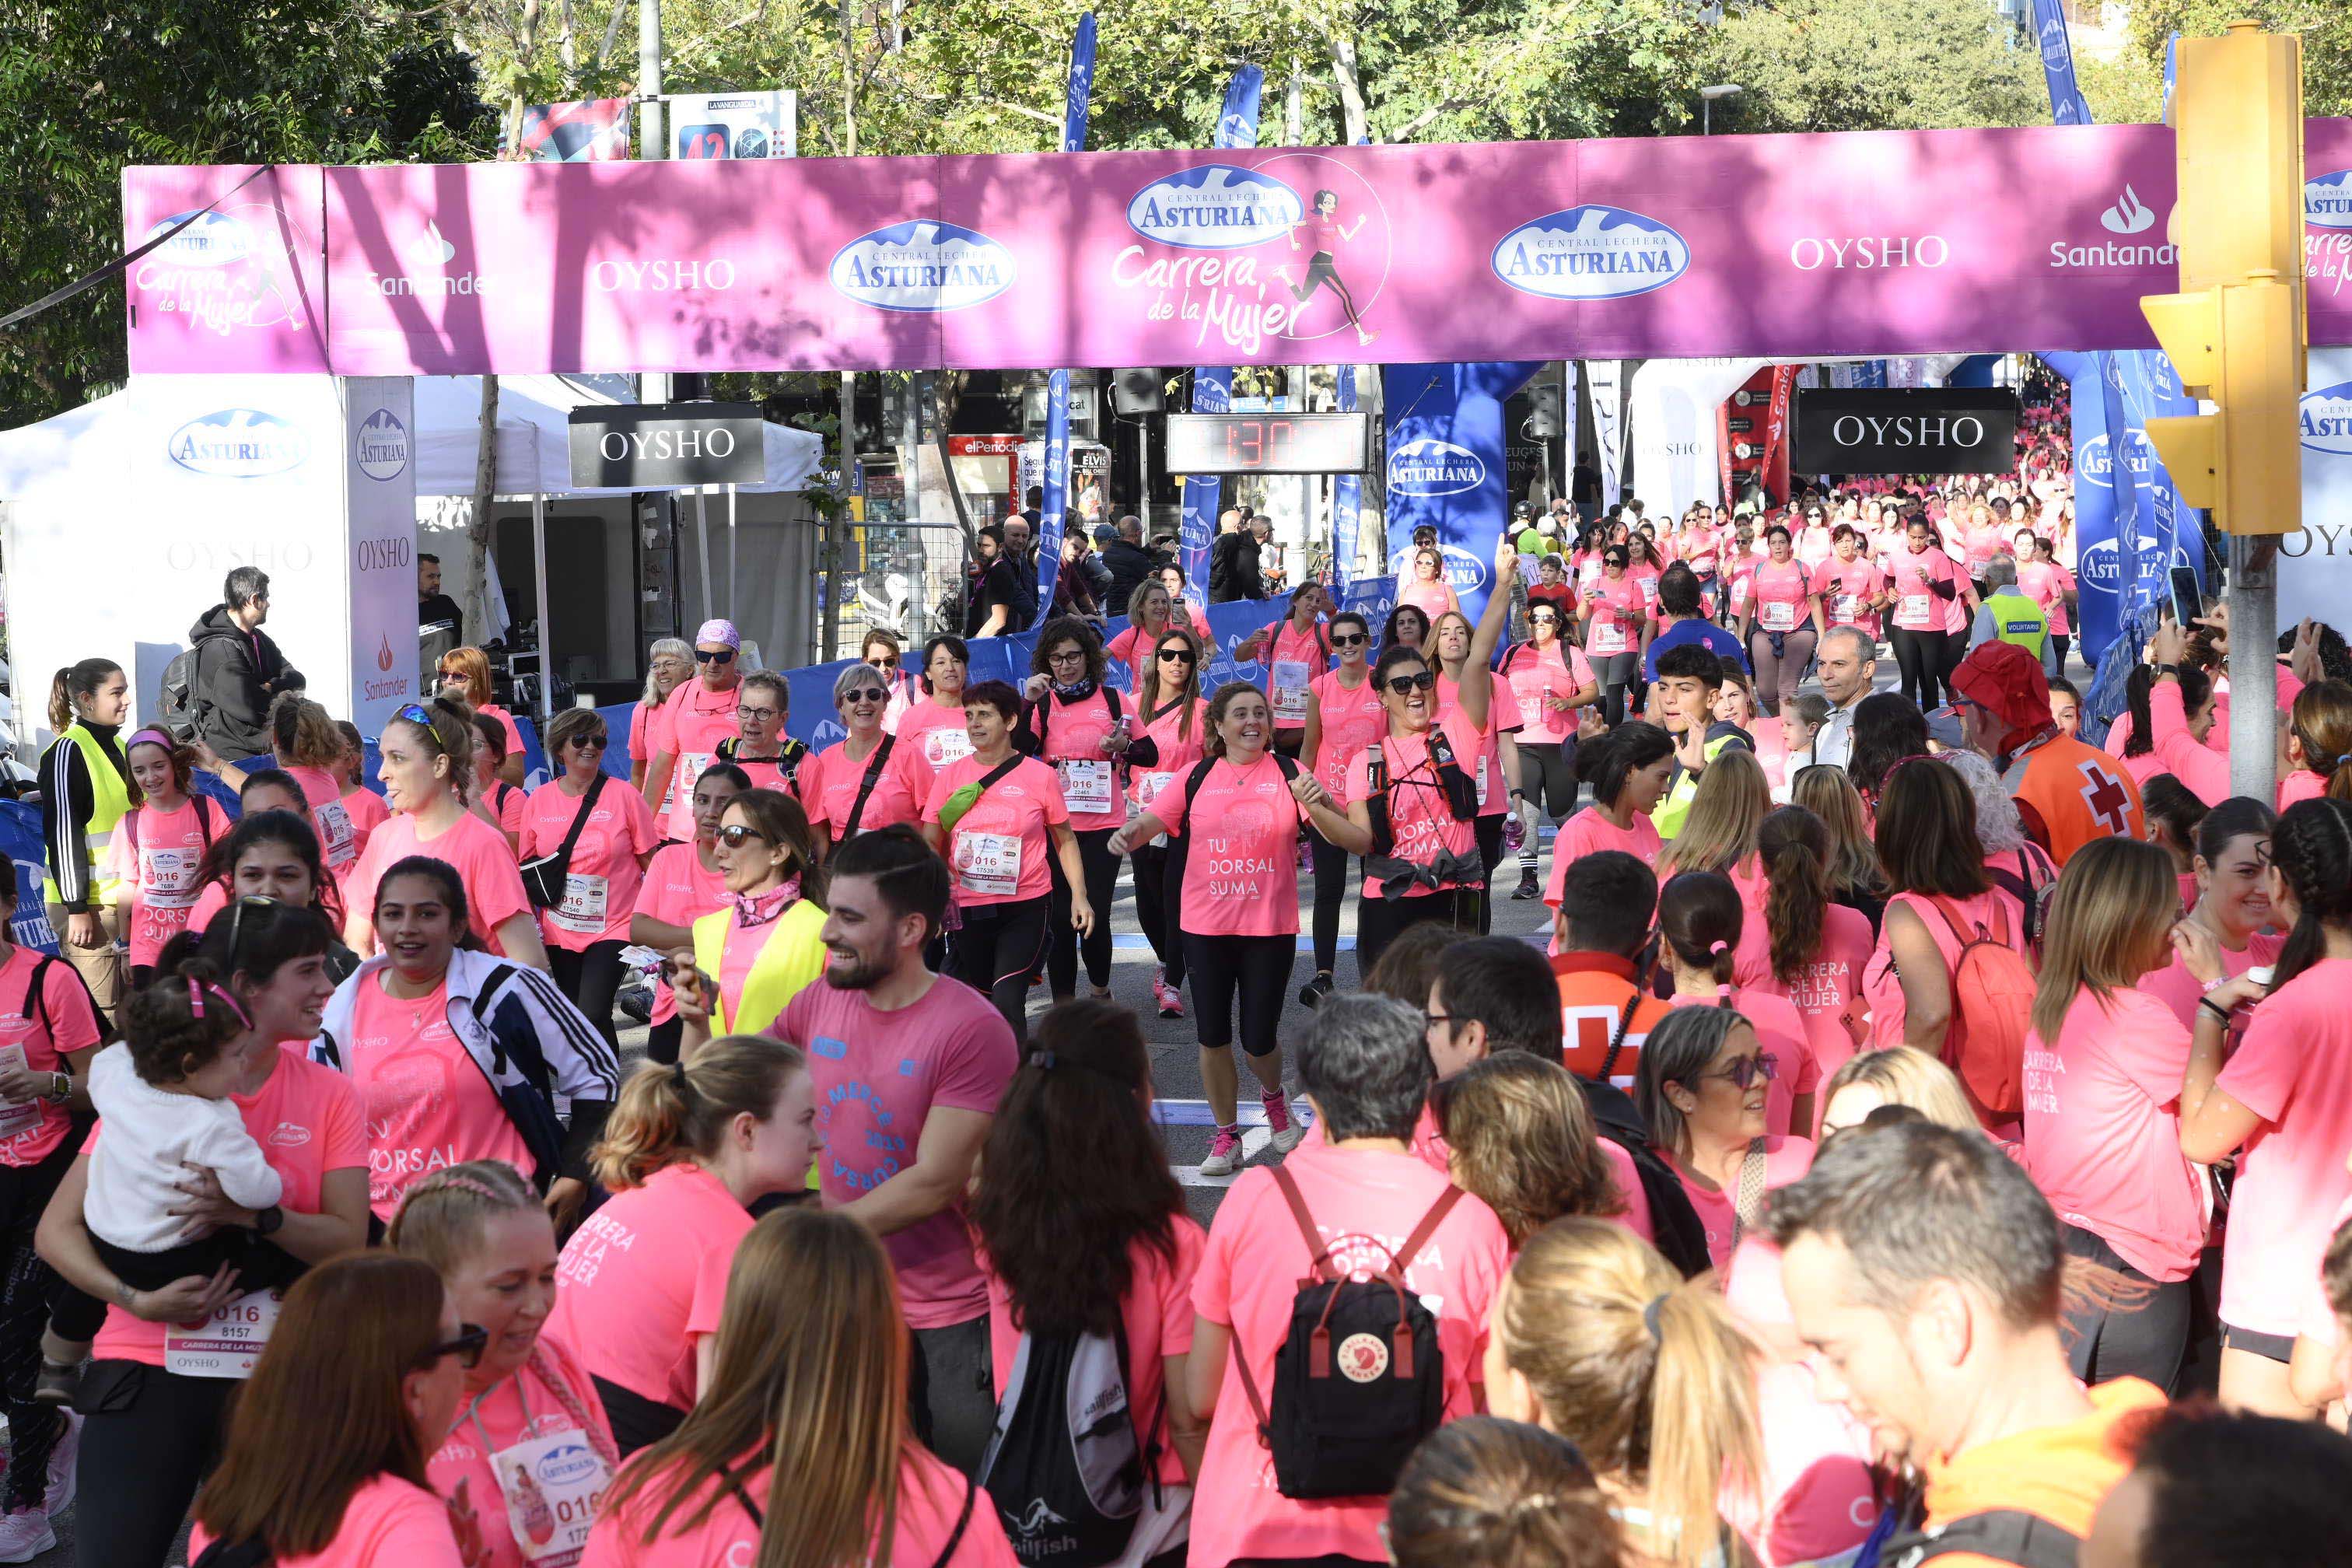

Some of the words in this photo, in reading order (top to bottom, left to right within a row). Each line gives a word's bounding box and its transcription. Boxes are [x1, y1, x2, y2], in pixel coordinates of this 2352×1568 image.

[1167, 194, 1223, 202] CENTRAL
[1140, 197, 1291, 228] ASTURIANA
[1538, 236, 1598, 247] CENTRAL
[1605, 236, 1668, 247] LECHERA
[873, 252, 931, 261] CENTRAL
[1507, 242, 1675, 277] ASTURIANA
[1791, 236, 1948, 270] OYSHO
[2050, 241, 2180, 268] Santand
[593, 259, 737, 292] OYSHO
[846, 254, 1001, 288] ASTURIANA
[1111, 245, 1258, 289] Carrera
[2322, 258, 2336, 278] la
[158, 295, 176, 312] de
[1147, 290, 1174, 320] de
[1181, 289, 1200, 320] la
[1195, 284, 1312, 356] Mujer
[1833, 416, 1984, 448] OYSHO
[360, 440, 405, 464] ASTURIANA
[600, 428, 735, 461] OYSHO
[1083, 456, 1106, 464] ELVIS
[1391, 463, 1478, 483] ASTURIANA
[166, 541, 312, 572] OYSHO
[358, 537, 409, 572] OYSHO
[364, 677, 408, 702] Santander
[1207, 838, 1227, 853] TU
[975, 856, 997, 866] 016
[1209, 858, 1276, 874] DORSAL
[156, 872, 179, 881] 016
[1209, 880, 1259, 895] SUMA
[562, 895, 583, 906] 016
[1816, 977, 1838, 992] LA
[1788, 992, 1841, 1008] MUJER
[584, 1237, 607, 1264] LA
[215, 1306, 261, 1322] 016
[222, 1327, 250, 1338] 8157
[181, 1342, 220, 1350] CARRERA
[233, 1342, 244, 1351] LA
[177, 1358, 219, 1368] OYSHO
[1085, 1384, 1122, 1416] sailfish
